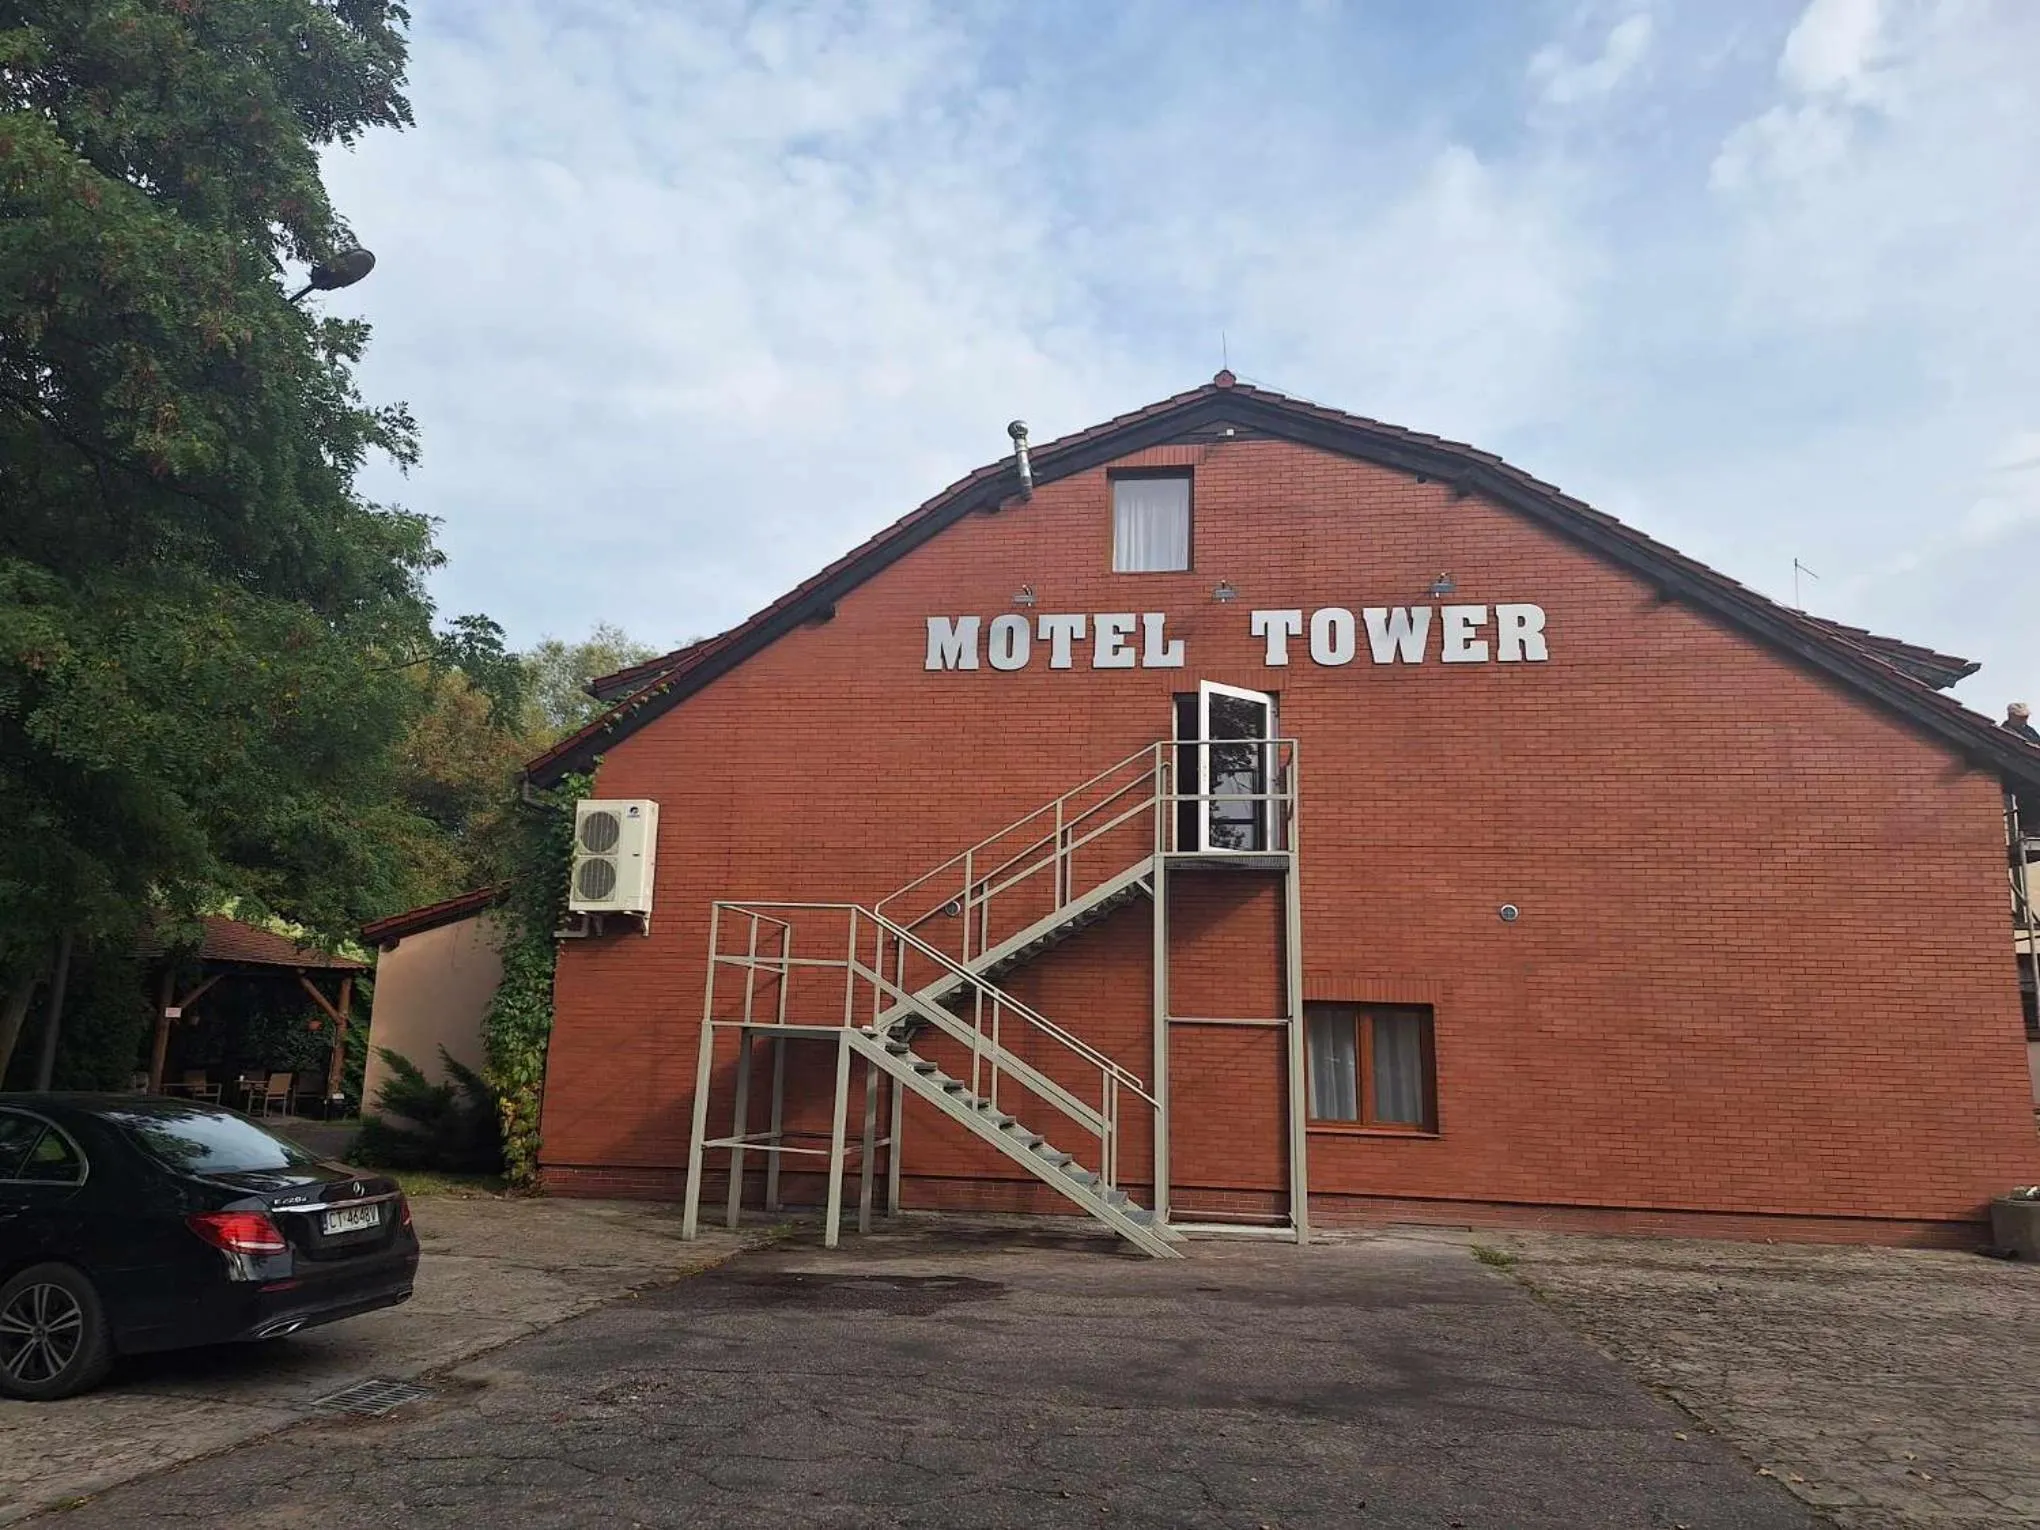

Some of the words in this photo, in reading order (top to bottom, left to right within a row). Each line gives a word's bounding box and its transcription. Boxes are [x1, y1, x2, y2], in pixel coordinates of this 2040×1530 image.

[925, 612, 1186, 671] MOTEL
[1250, 603, 1549, 666] TOWER
[329, 1211, 345, 1228] CT
